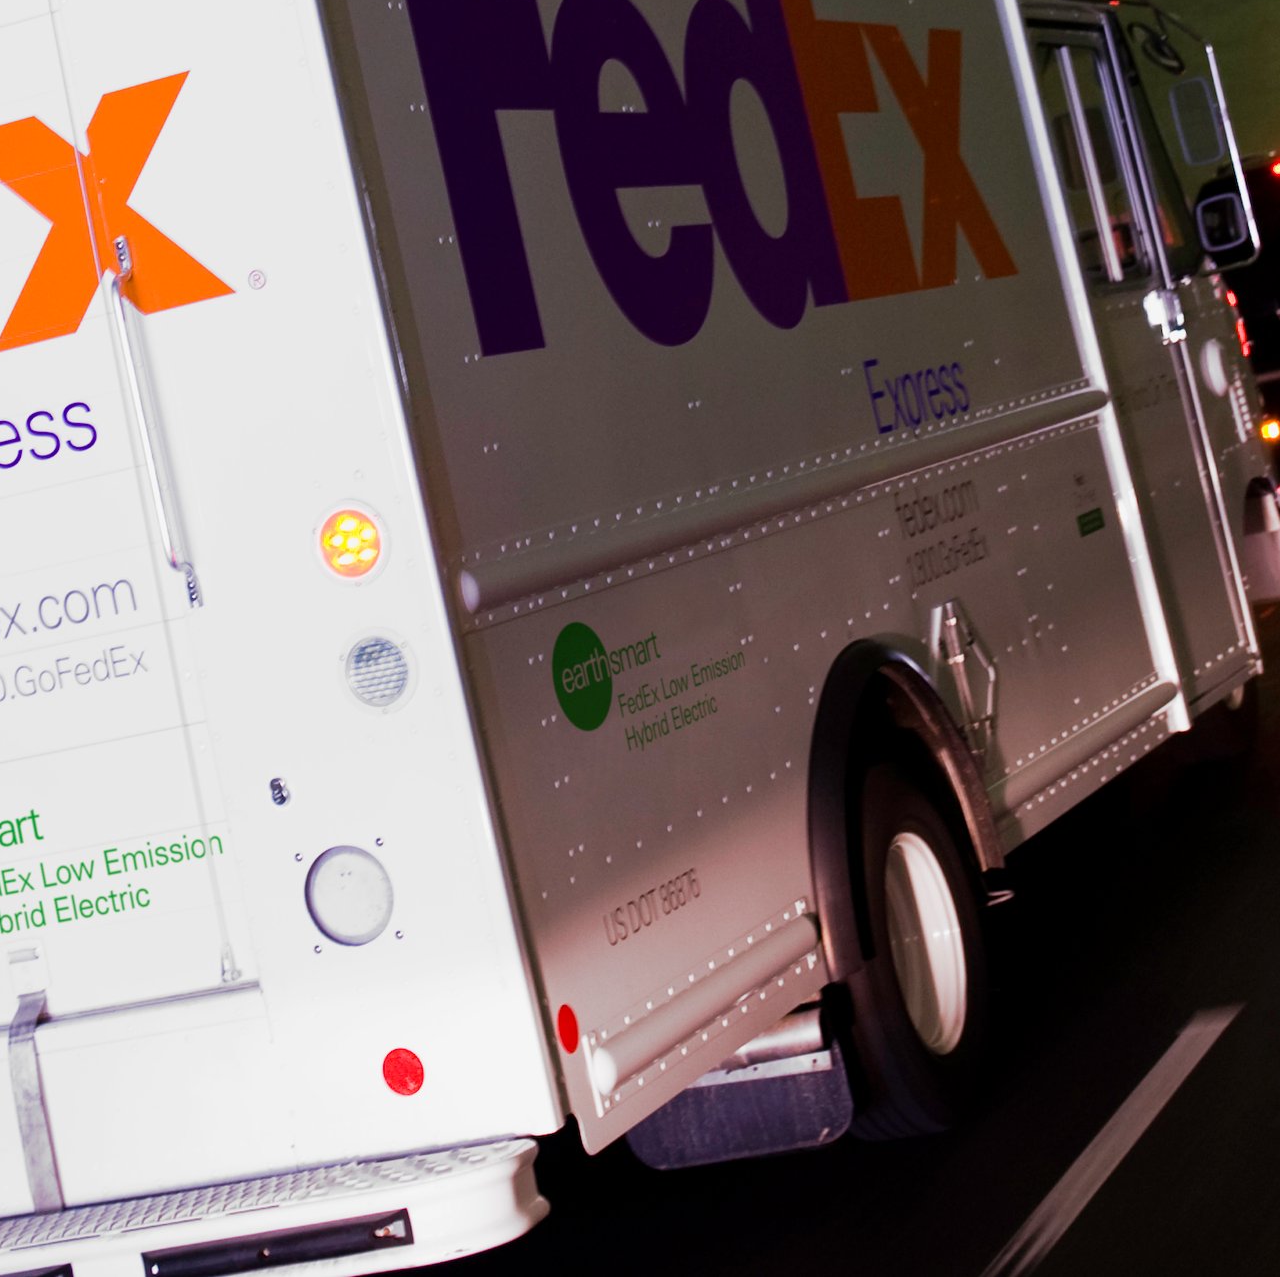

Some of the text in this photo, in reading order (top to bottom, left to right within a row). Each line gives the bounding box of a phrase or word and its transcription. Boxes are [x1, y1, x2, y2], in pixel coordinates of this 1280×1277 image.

[863, 358, 970, 436] Express
[618, 650, 746, 718] FedEx Low Emission
[624, 693, 718, 752] Hybrid Electric
[40, 858, 95, 888] Low
[104, 834, 224, 878] Emission
[54, 883, 151, 924] Electric
[602, 906, 629, 947] US
[627, 887, 659, 934] DOT
